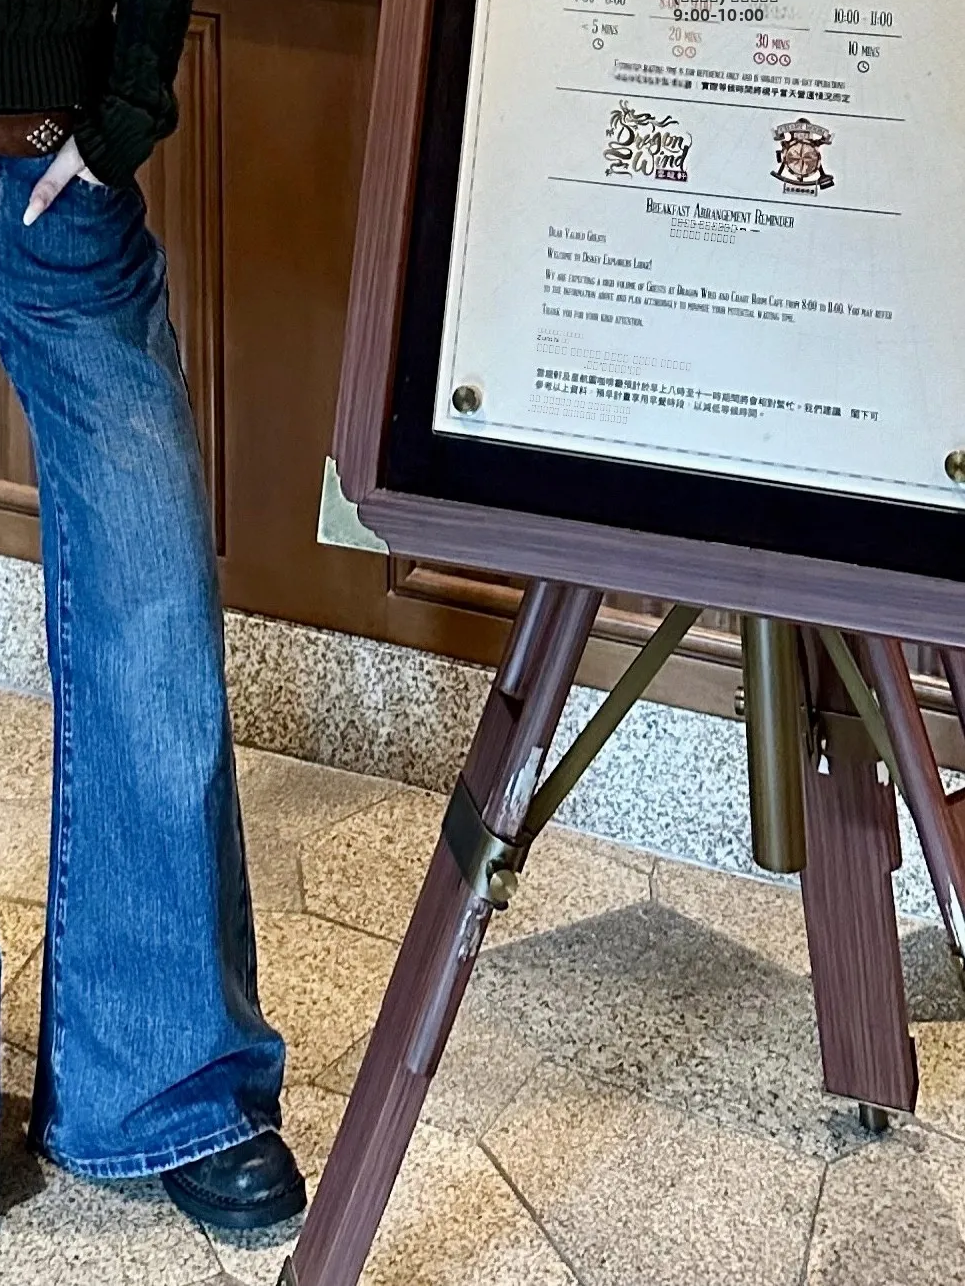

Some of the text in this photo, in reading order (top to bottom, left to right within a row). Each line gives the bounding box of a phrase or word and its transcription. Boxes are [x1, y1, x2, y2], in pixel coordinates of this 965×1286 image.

[591, 18, 599, 34] 5
[834, 8, 860, 25] 10:00
[870, 10, 893, 27] 11:00
[668, 26, 682, 42] 20
[755, 33, 790, 50] 30 MINS
[848, 40, 881, 58] 10 MINS
[617, 126, 685, 155] Dragon
[632, 145, 689, 176] Wind
